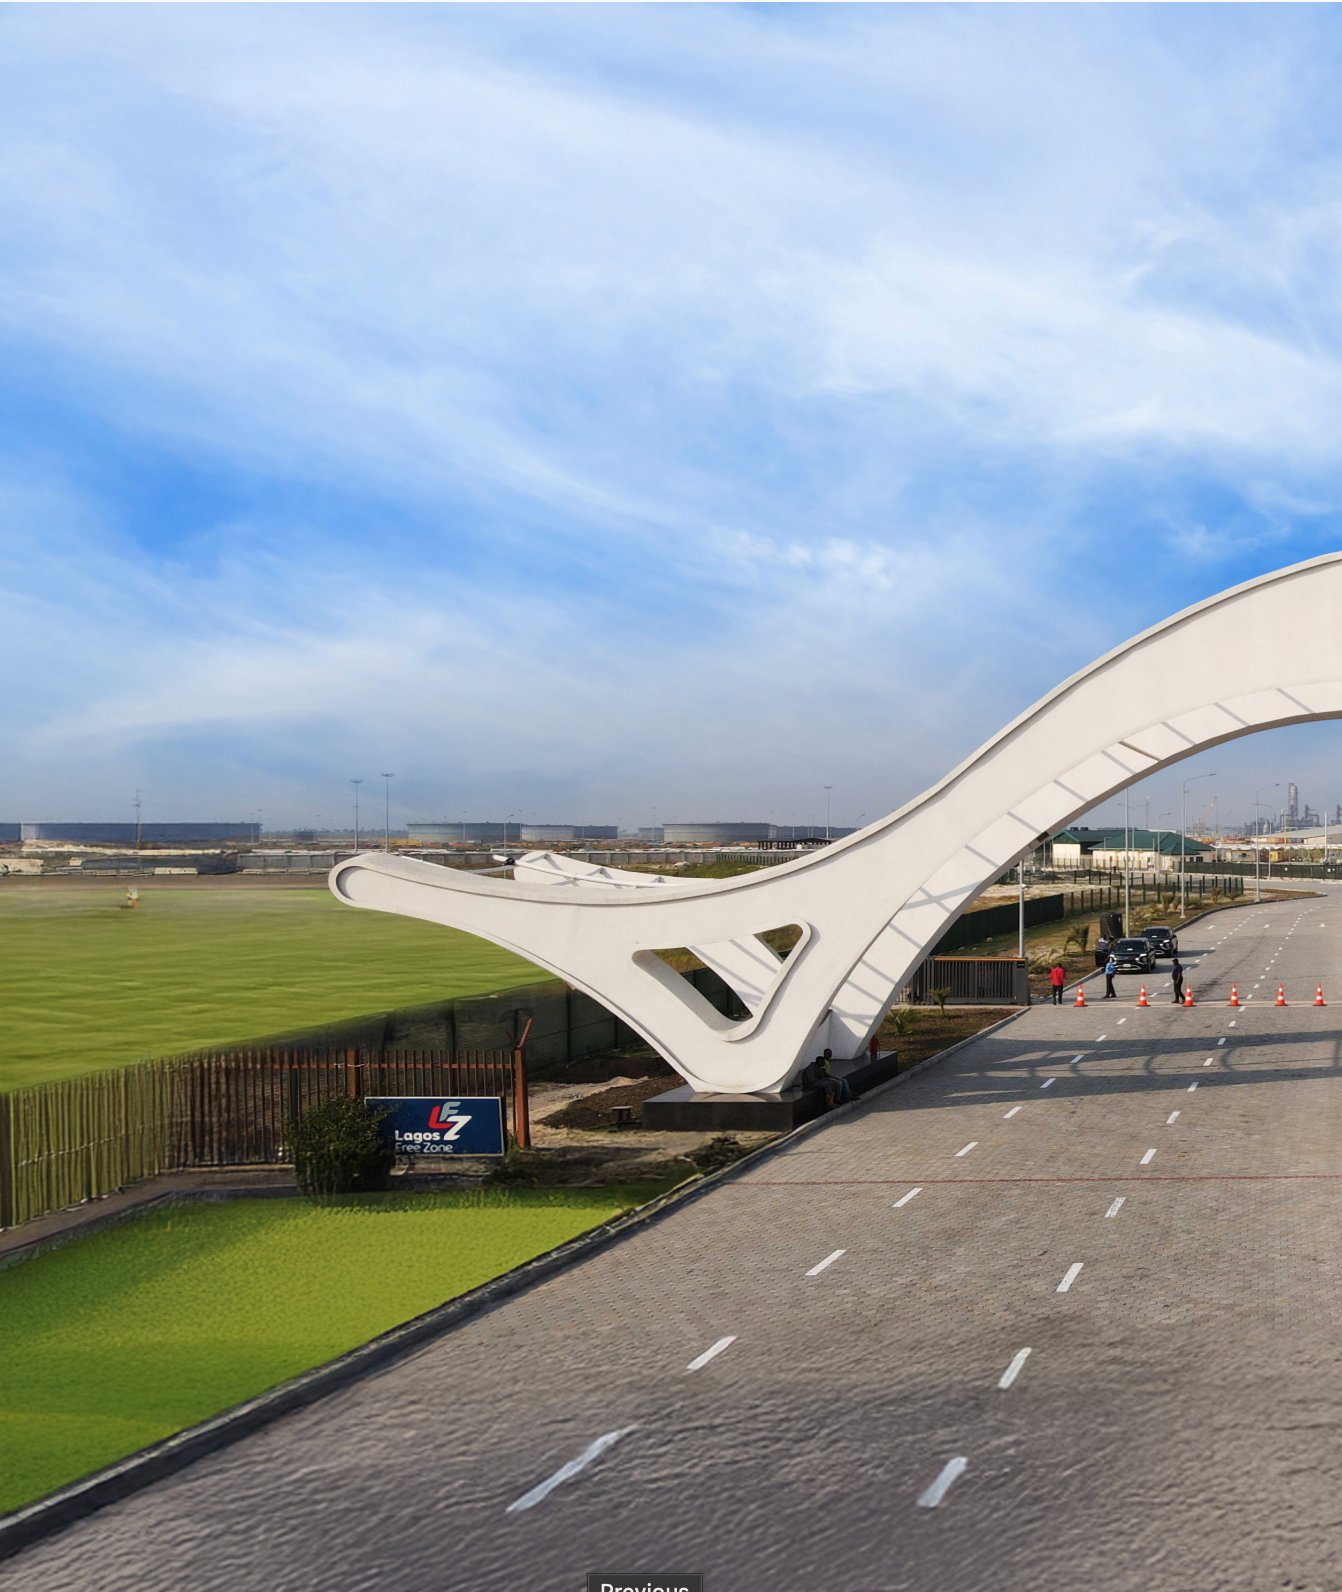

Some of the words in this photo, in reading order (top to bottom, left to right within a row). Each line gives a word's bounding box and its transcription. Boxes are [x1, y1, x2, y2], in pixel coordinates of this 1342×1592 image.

[428, 1102, 472, 1140] LFZ
[395, 1130, 440, 1143] Lagos
[395, 1142, 421, 1152] Free
[423, 1142, 453, 1152] Zone
